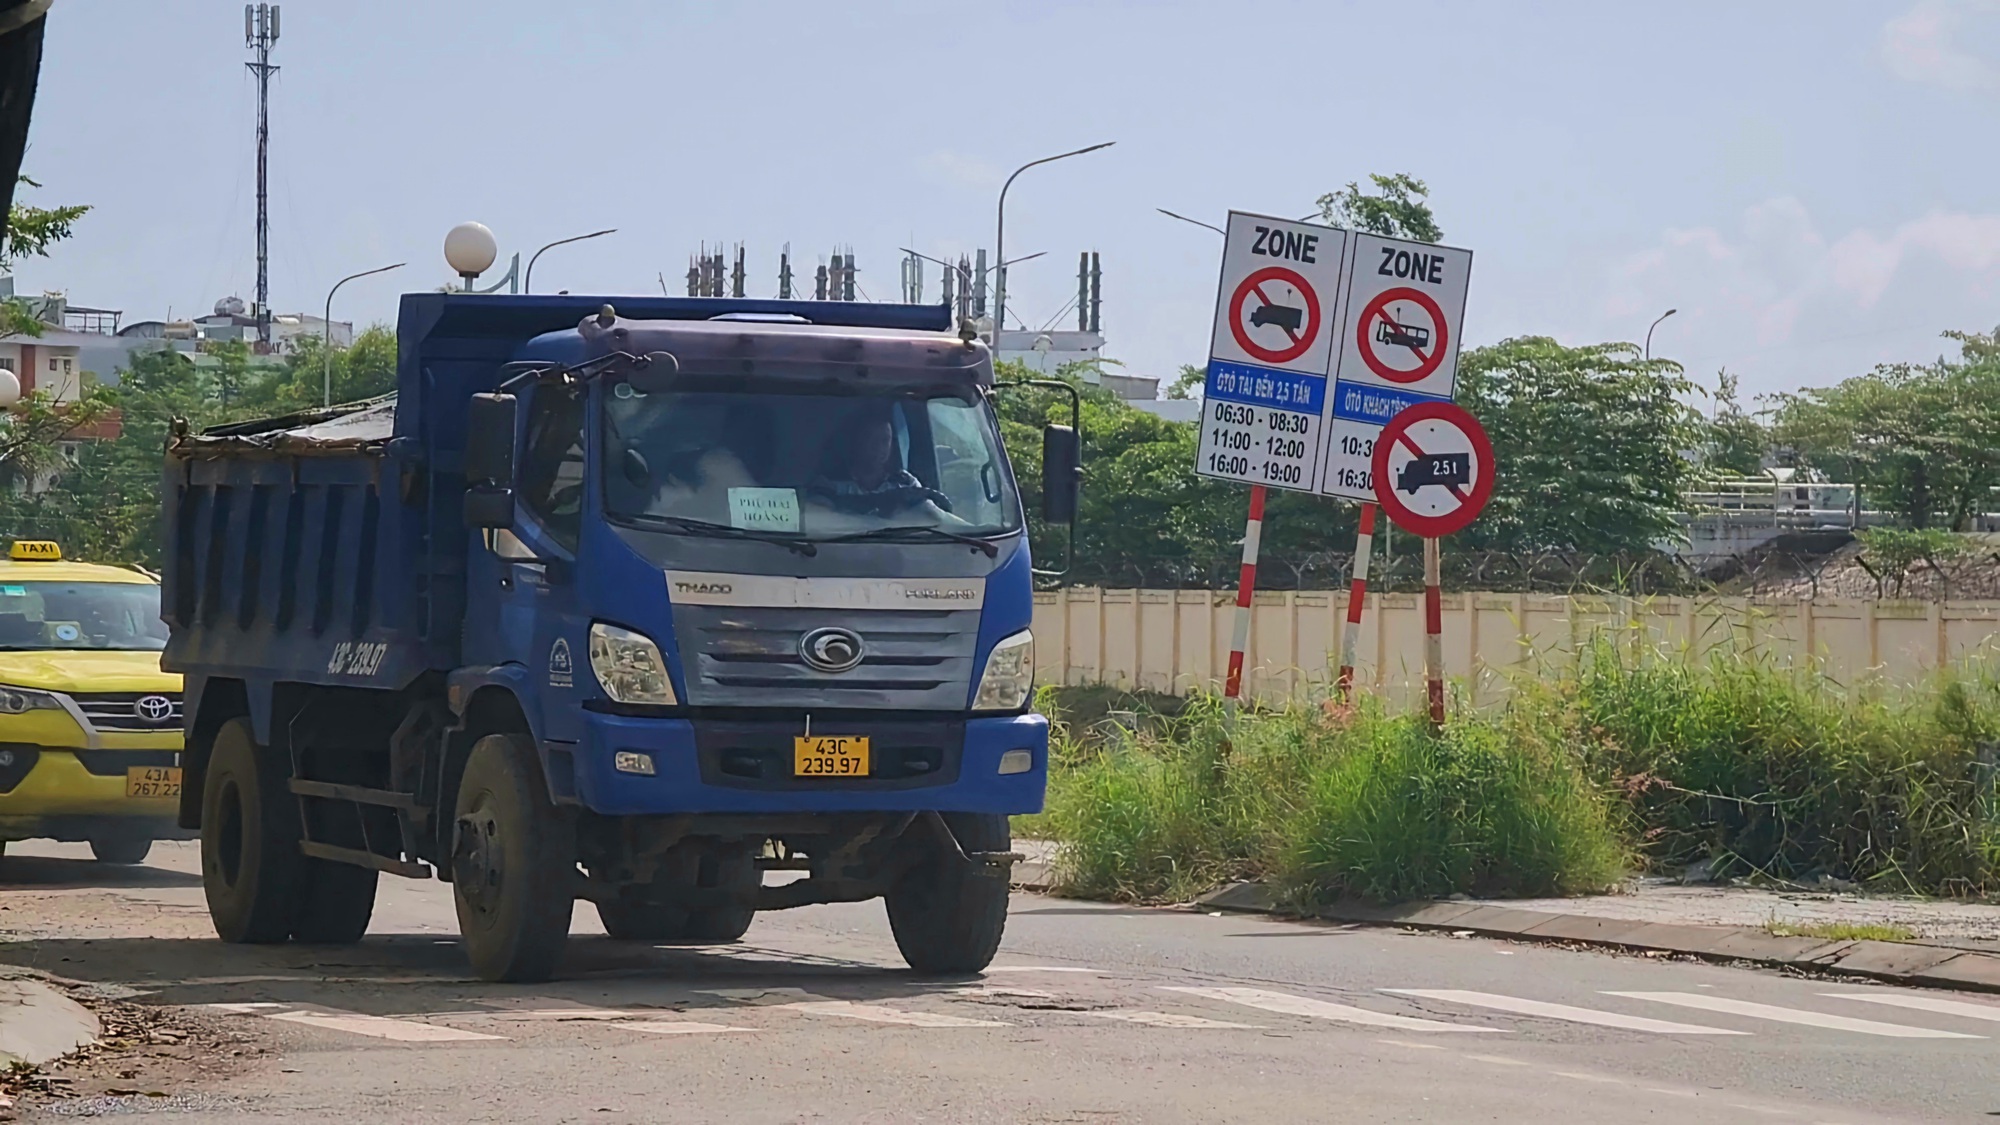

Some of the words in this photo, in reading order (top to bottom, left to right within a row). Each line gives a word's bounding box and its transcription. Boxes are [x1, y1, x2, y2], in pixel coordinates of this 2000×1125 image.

[1251, 226, 1319, 264] ZONE
[1378, 246, 1445, 284] ZONE
[1276, 381, 1289, 404] 2,5
[1215, 403, 1254, 426] 06:30
[1269, 412, 1308, 434] 08:30
[1212, 428, 1251, 451] 11:00
[1266, 436, 1305, 459] 12:00
[1341, 435, 1373, 458] 10:3
[1209, 452, 1248, 476] 16:00
[1262, 460, 1301, 484] 19:00
[1432, 460, 1450, 476] 2.5
[1337, 467, 1374, 491] 16:30
[20, 543, 54, 553] TAXI
[675, 582, 732, 594] THACO
[905, 589, 976, 600] FORLAND
[815, 738, 848, 755] 43C
[145, 769, 170, 782] 43A
[802, 757, 861, 774] 239.97
[133, 782, 180, 796] 267.22
